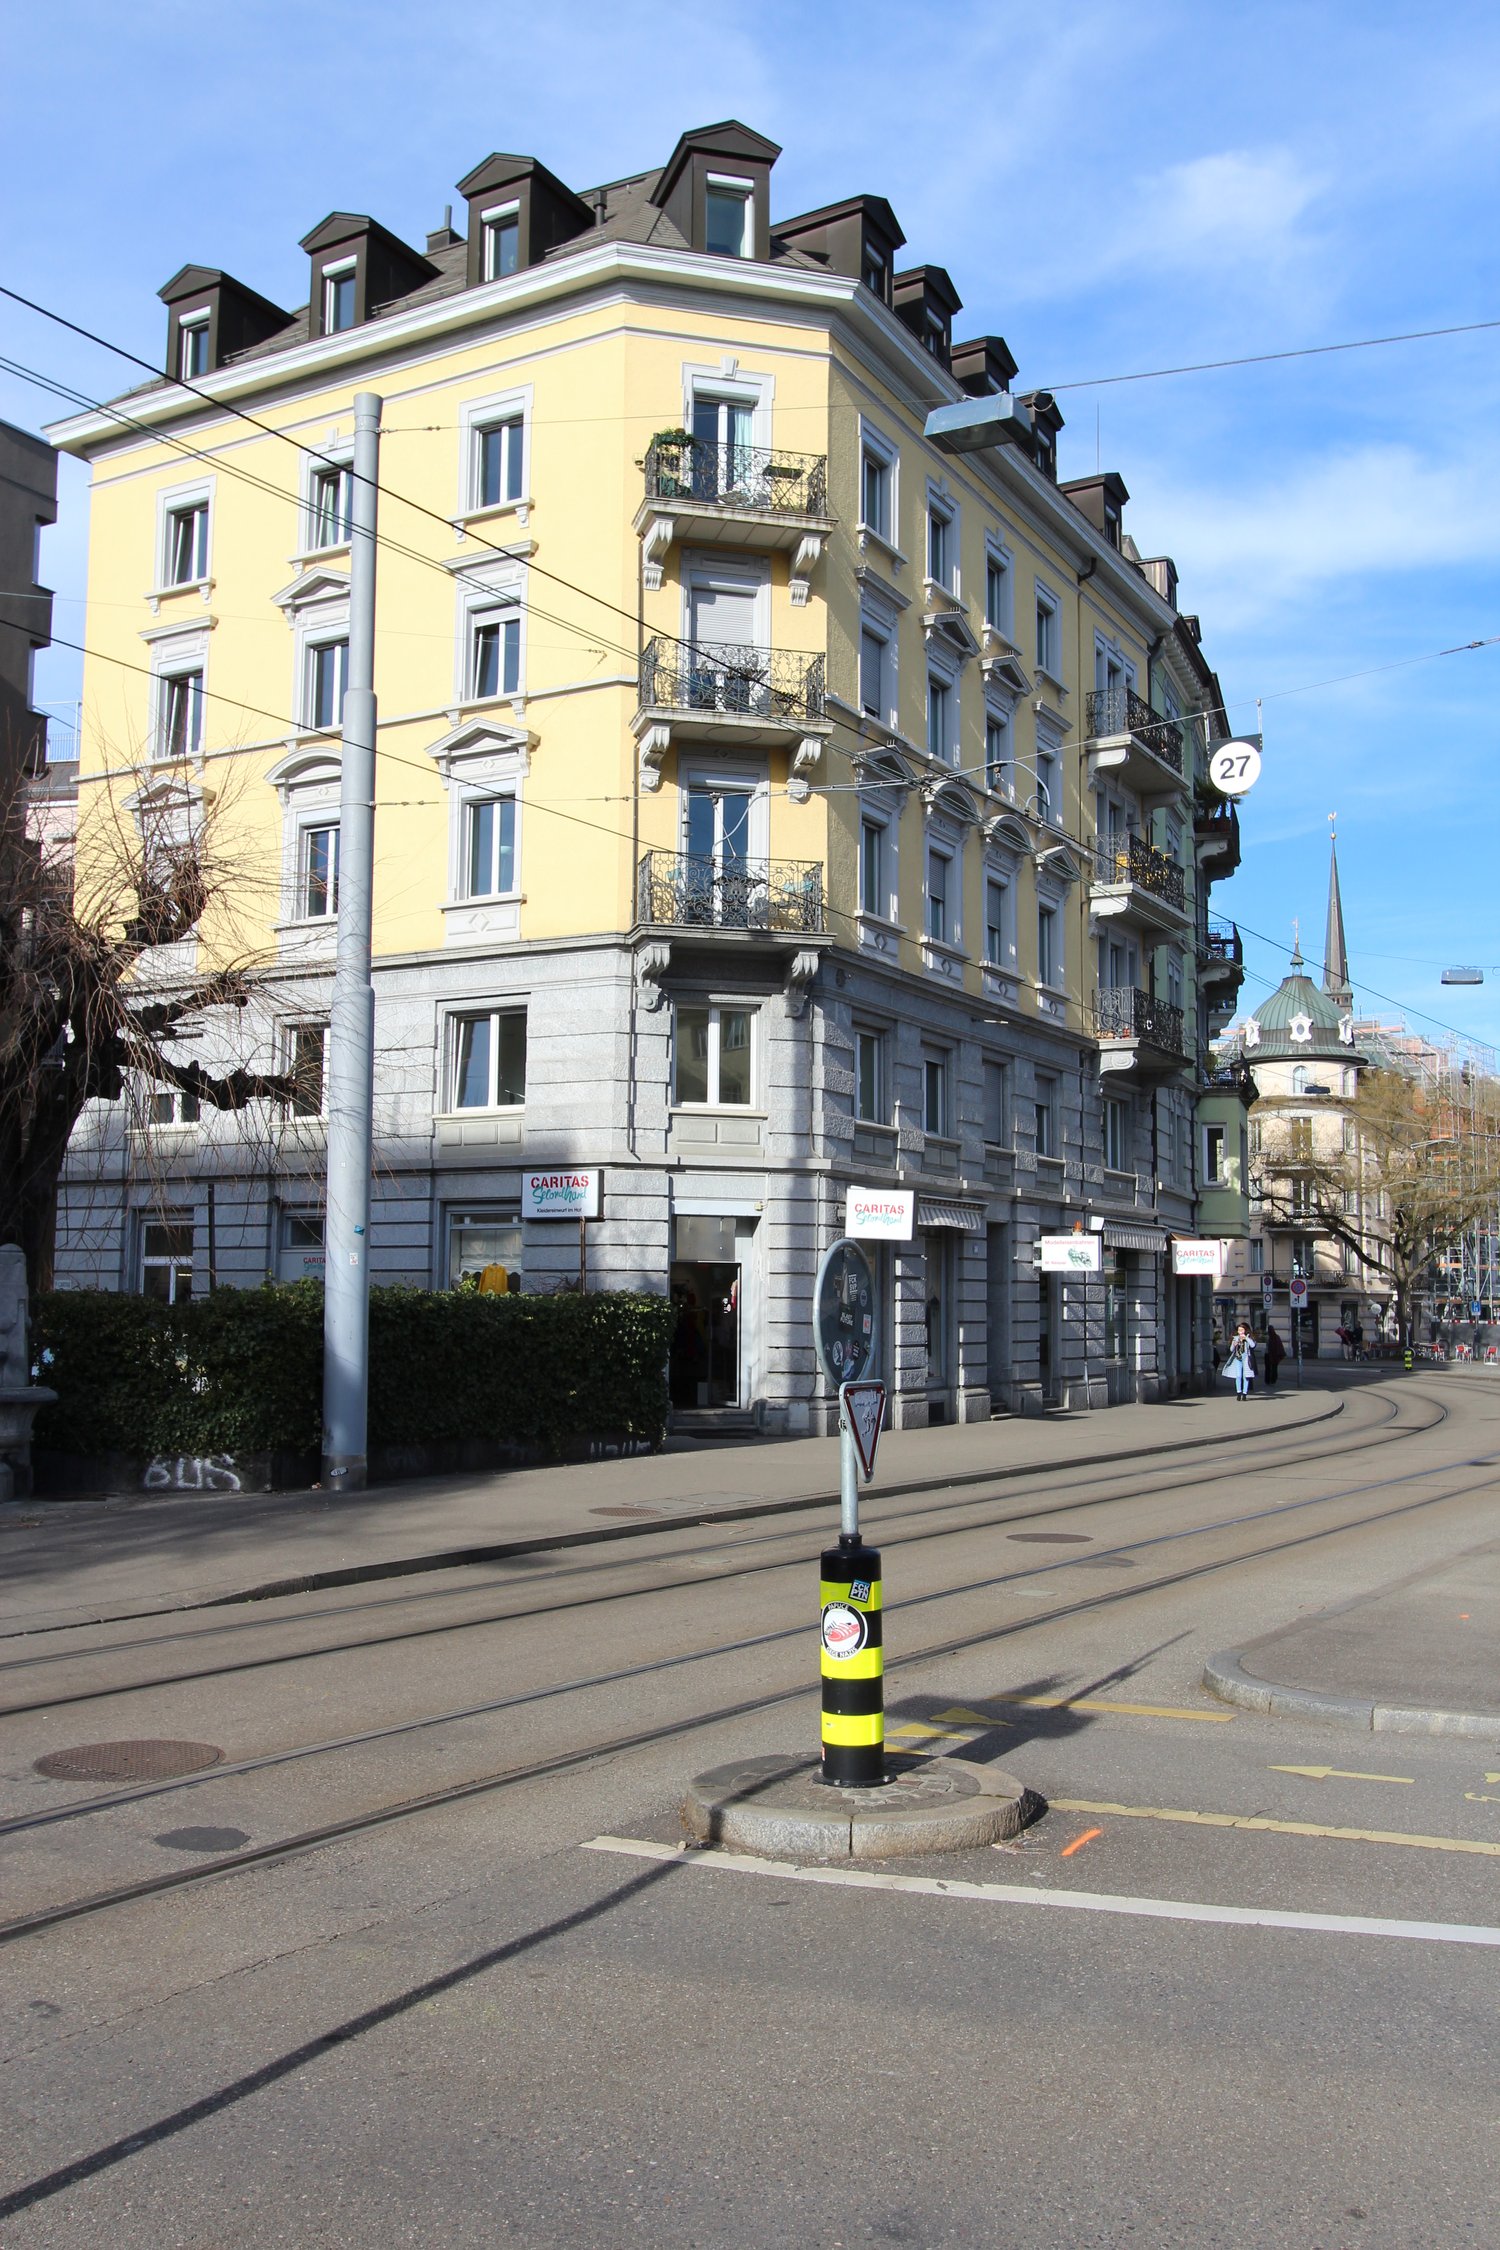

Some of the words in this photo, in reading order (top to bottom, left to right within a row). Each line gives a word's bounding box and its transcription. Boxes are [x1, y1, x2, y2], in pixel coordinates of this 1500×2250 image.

[1219, 754, 1251, 780] 27
[531, 1175, 589, 1188] CARITAS
[854, 1203, 904, 1215] CARITAS
[1176, 1249, 1215, 1257] CARITAS
[852, 1581, 871, 1592] FCK
